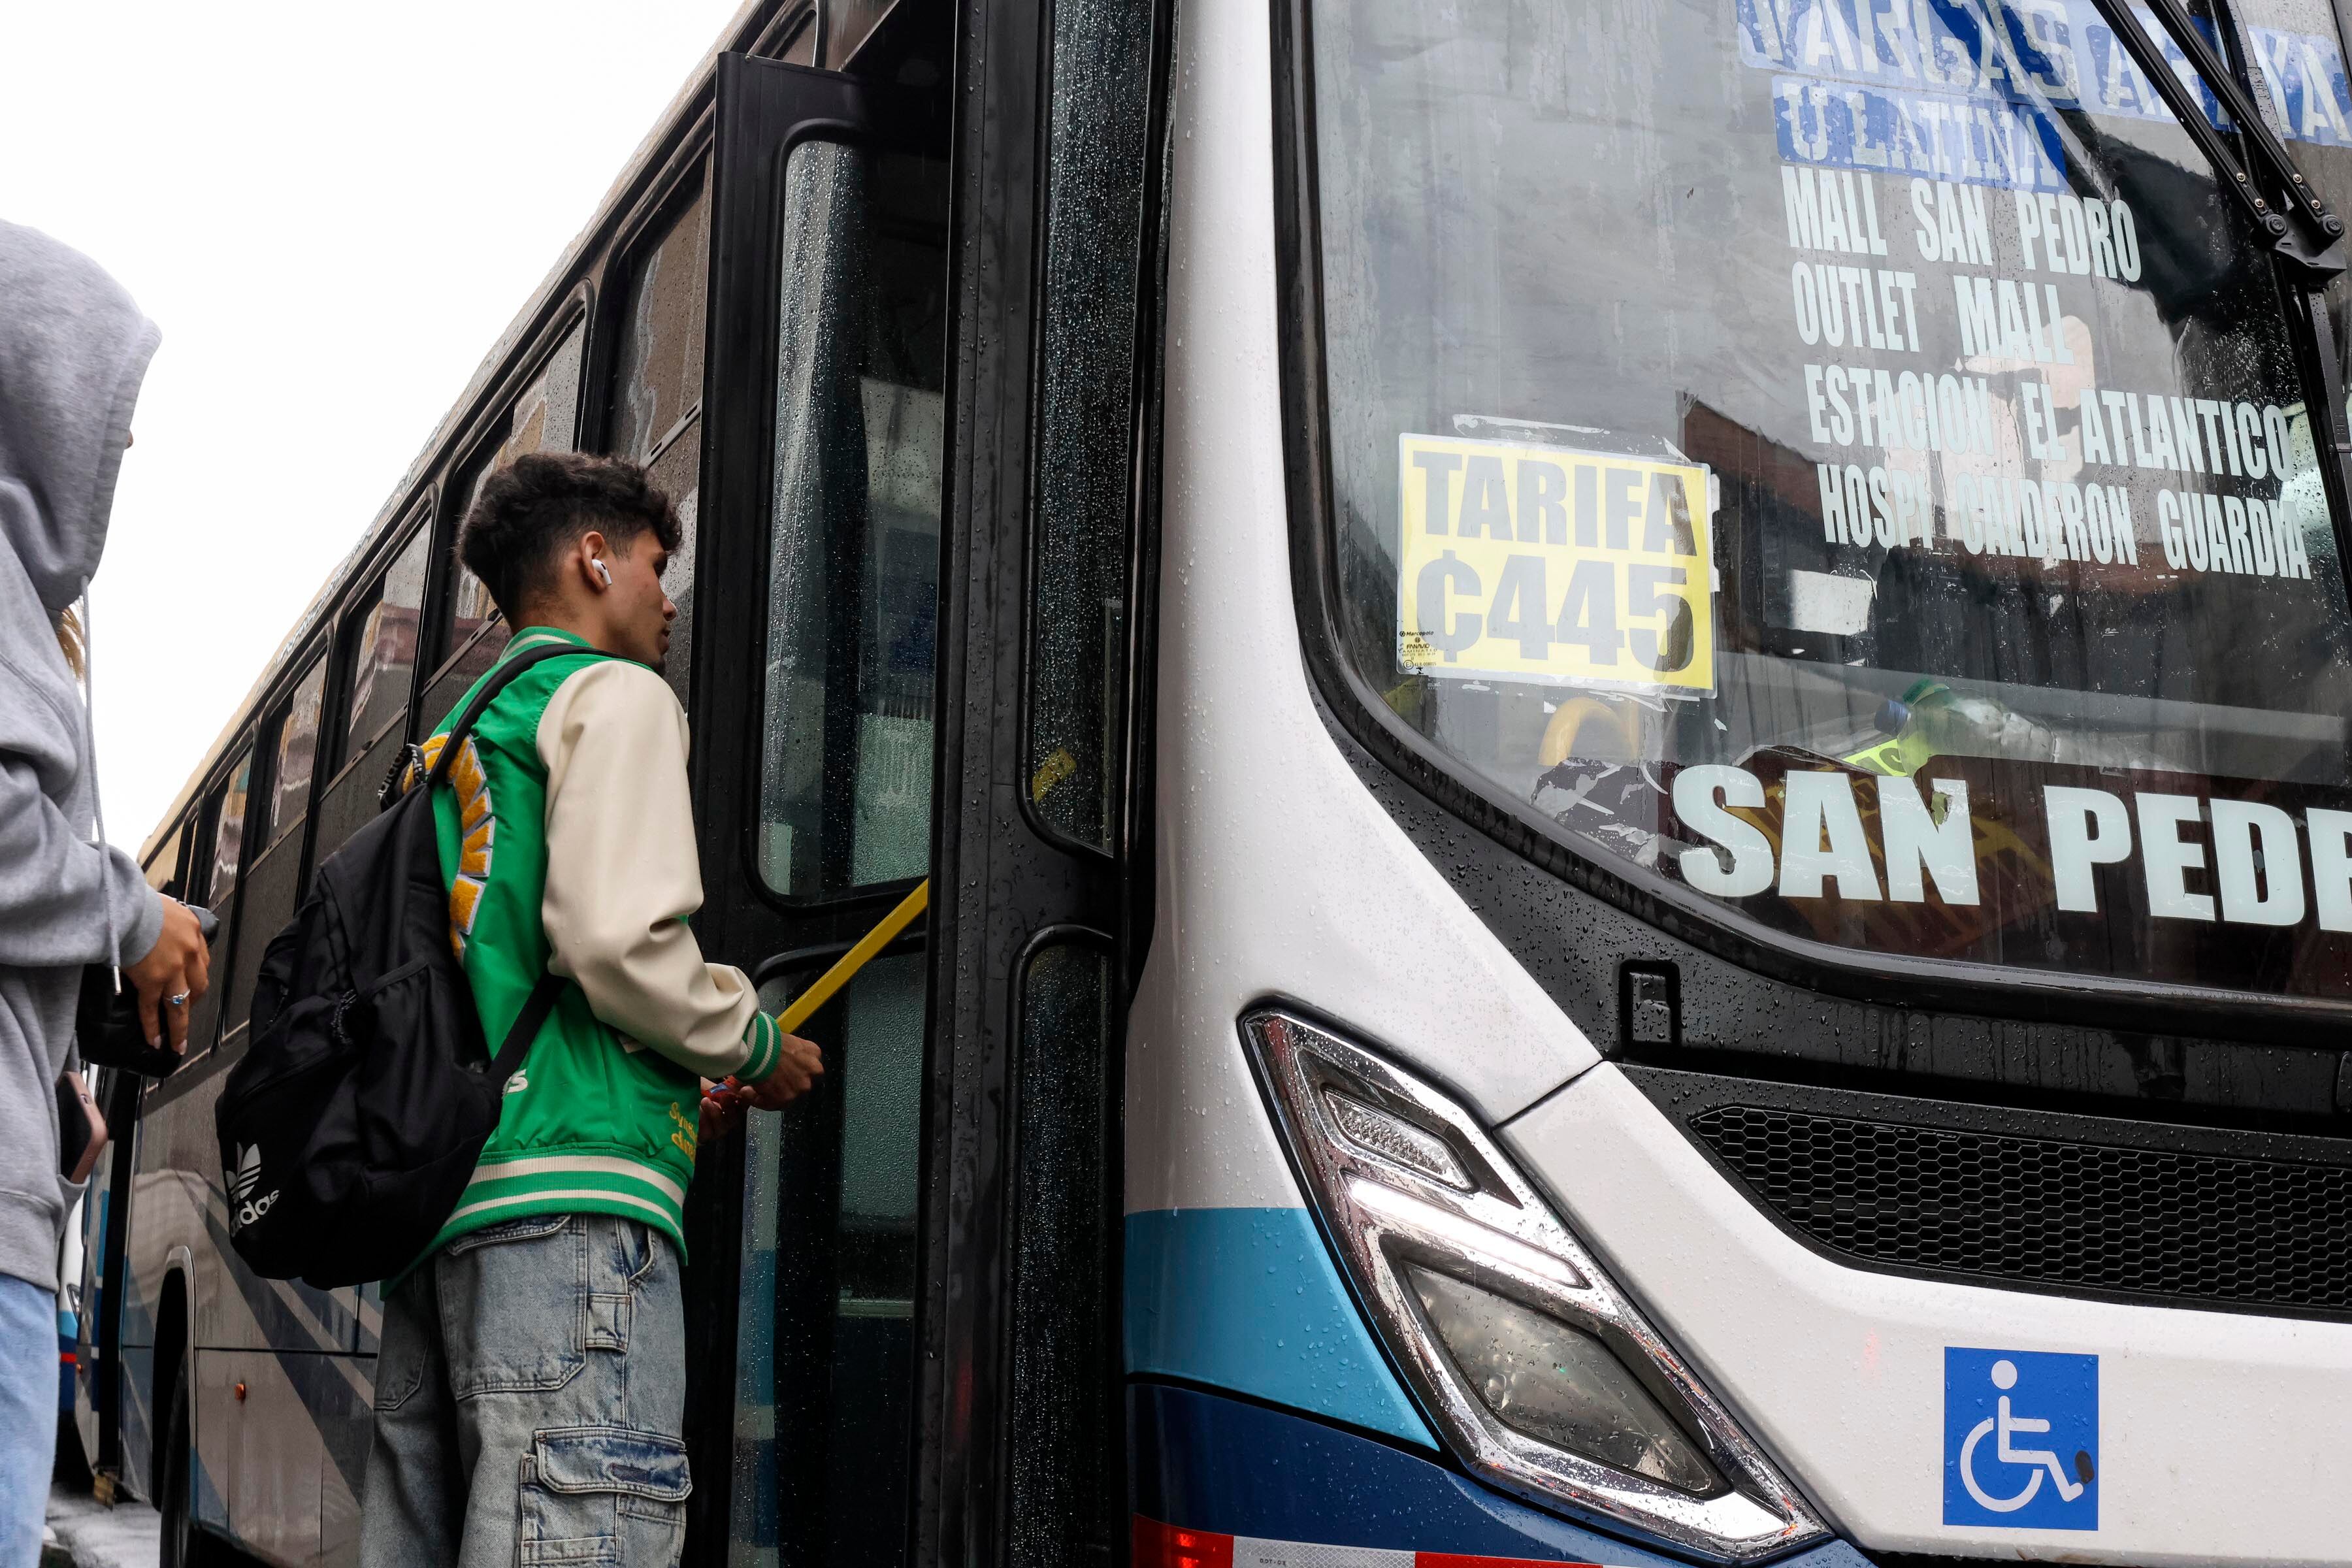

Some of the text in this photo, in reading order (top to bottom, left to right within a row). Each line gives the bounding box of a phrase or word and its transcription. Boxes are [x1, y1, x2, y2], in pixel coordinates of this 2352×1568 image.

[2104, 18, 2352, 142] ARYA
[1781, 165, 2141, 282] MALL SAN PEDRO
[1791, 262, 2075, 365] OUTLET MALL
[1804, 364, 2293, 482] ESTACION EL ATLANTICO
[1413, 449, 1697, 557] TARIFA
[1817, 464, 2311, 580] HOSPI CALDERON GUARDIA
[1671, 764, 1980, 906] SAN
